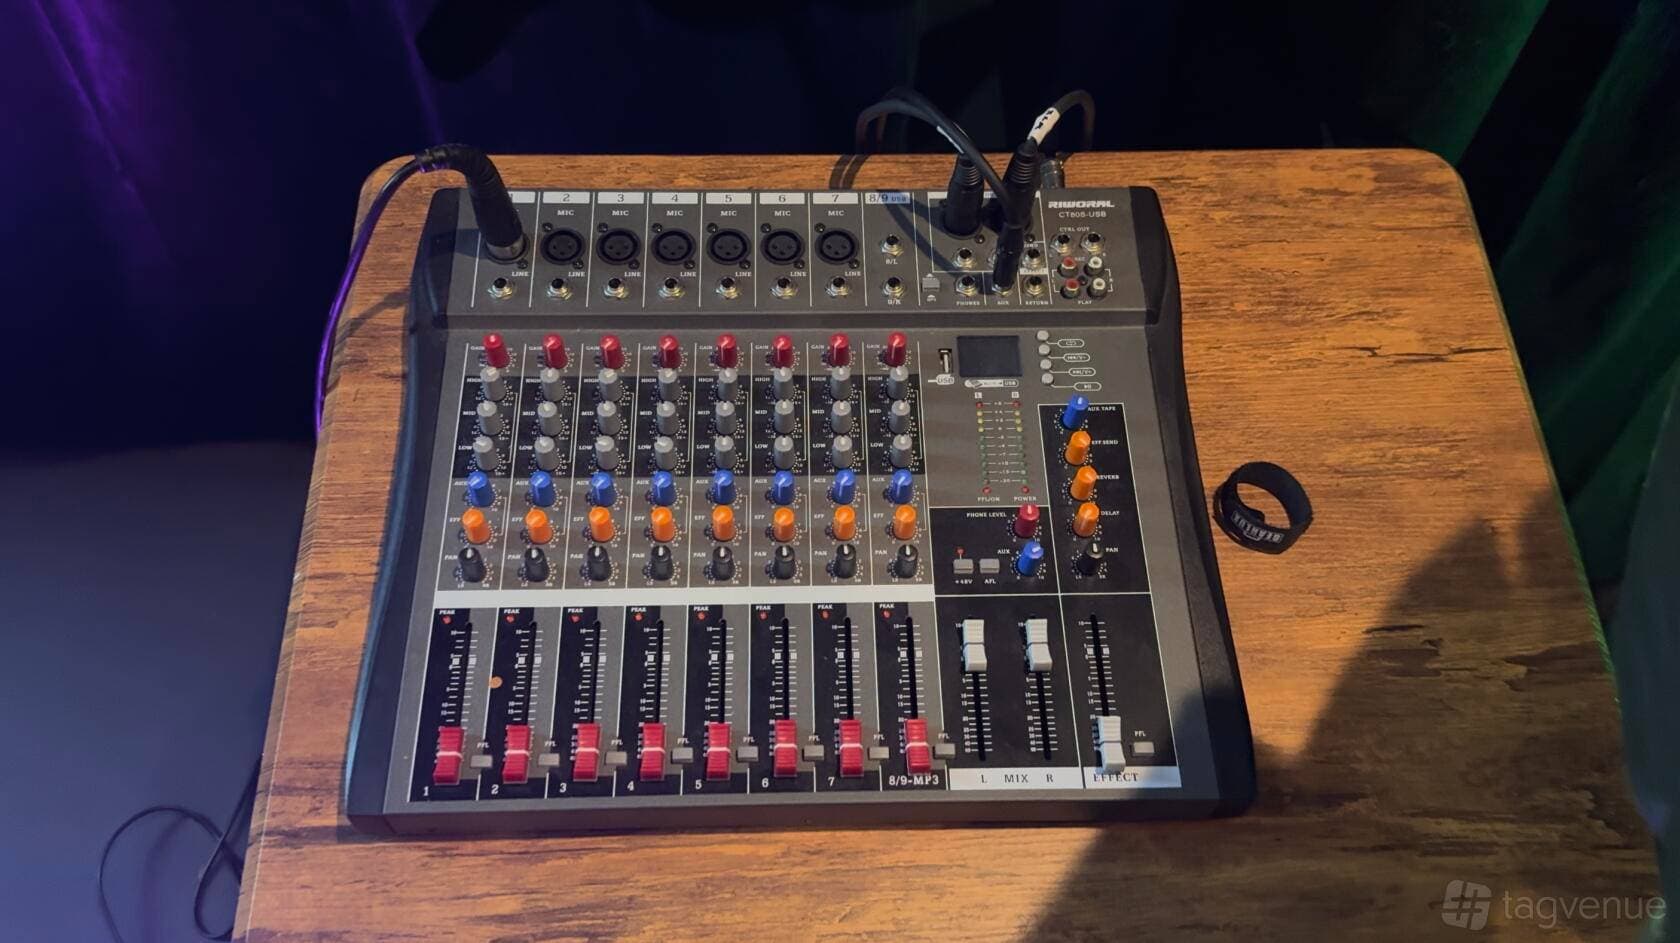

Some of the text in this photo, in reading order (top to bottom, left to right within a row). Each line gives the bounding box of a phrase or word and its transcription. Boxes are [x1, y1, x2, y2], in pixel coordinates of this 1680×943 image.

[563, 194, 570, 202] 2
[617, 194, 624, 202] 3
[671, 194, 678, 202] 4
[725, 194, 732, 202] 5
[779, 194, 786, 202] 6
[832, 194, 839, 202] 7
[828, 777, 835, 786] 7
[889, 774, 939, 786] 8/9-MP3
[981, 773, 1054, 783] L MIX R
[560, 783, 567, 792] 3
[627, 781, 635, 791] 4
[695, 780, 702, 789] 5
[762, 778, 769, 788] 6
[423, 786, 429, 796] 1
[491, 785, 499, 794] 2
